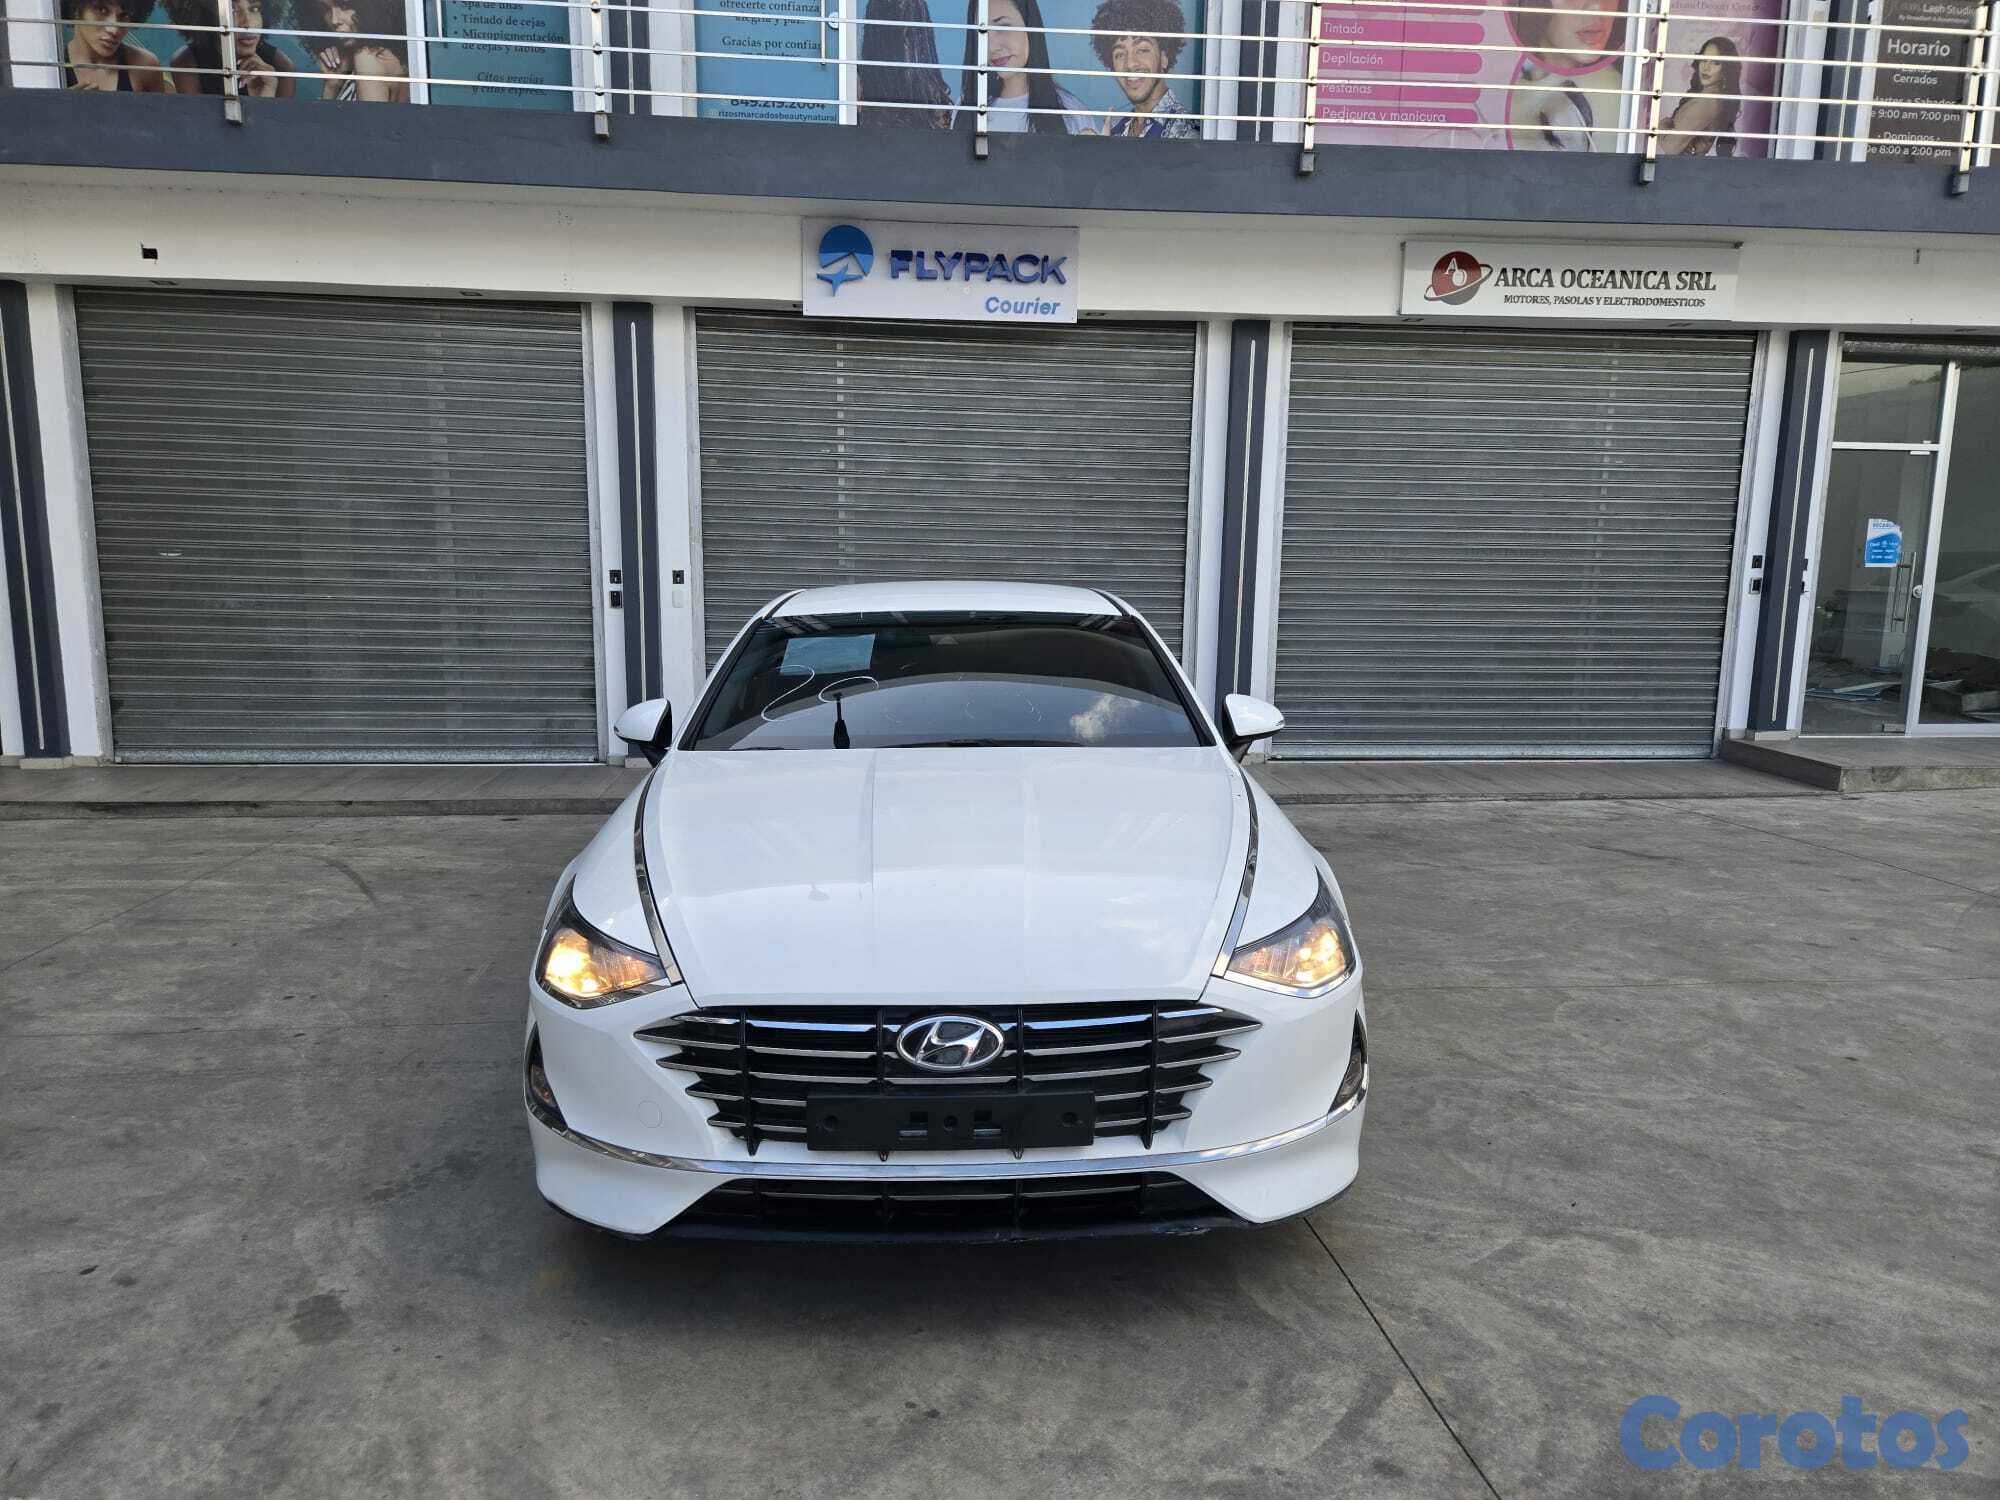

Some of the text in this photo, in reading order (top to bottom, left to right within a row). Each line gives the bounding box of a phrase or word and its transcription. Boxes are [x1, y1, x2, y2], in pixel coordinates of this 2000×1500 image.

[463, 15, 546, 29] Tintado de cejas
[1324, 22, 1364, 34] Tintado
[722, 36, 761, 47] Gracias
[765, 41, 782, 50] por
[1887, 38, 1951, 57] Horario
[1322, 52, 1384, 66] Depilación
[1893, 73, 1938, 85] Cerrados
[1322, 106, 1376, 121] Pedicura
[1391, 109, 1448, 122] manicura
[1878, 109, 1900, 119] 9:00
[1902, 112, 1918, 120] am
[1920, 111, 1942, 120] 7:00
[1943, 113, 1960, 122] pm
[1880, 145, 1901, 154] 8:00
[1903, 147, 1909, 155] a
[1911, 146, 1933, 156] 2:00
[1934, 149, 1951, 158] pm
[890, 249, 1068, 285] FLYPACK
[1494, 267, 1717, 291] ARCA OCEANICA SRL
[985, 296, 1061, 315] Courier
[1504, 294, 1551, 305] MOTORES,
[1553, 295, 1594, 305] PASOLAS
[1595, 296, 1604, 305] Y
